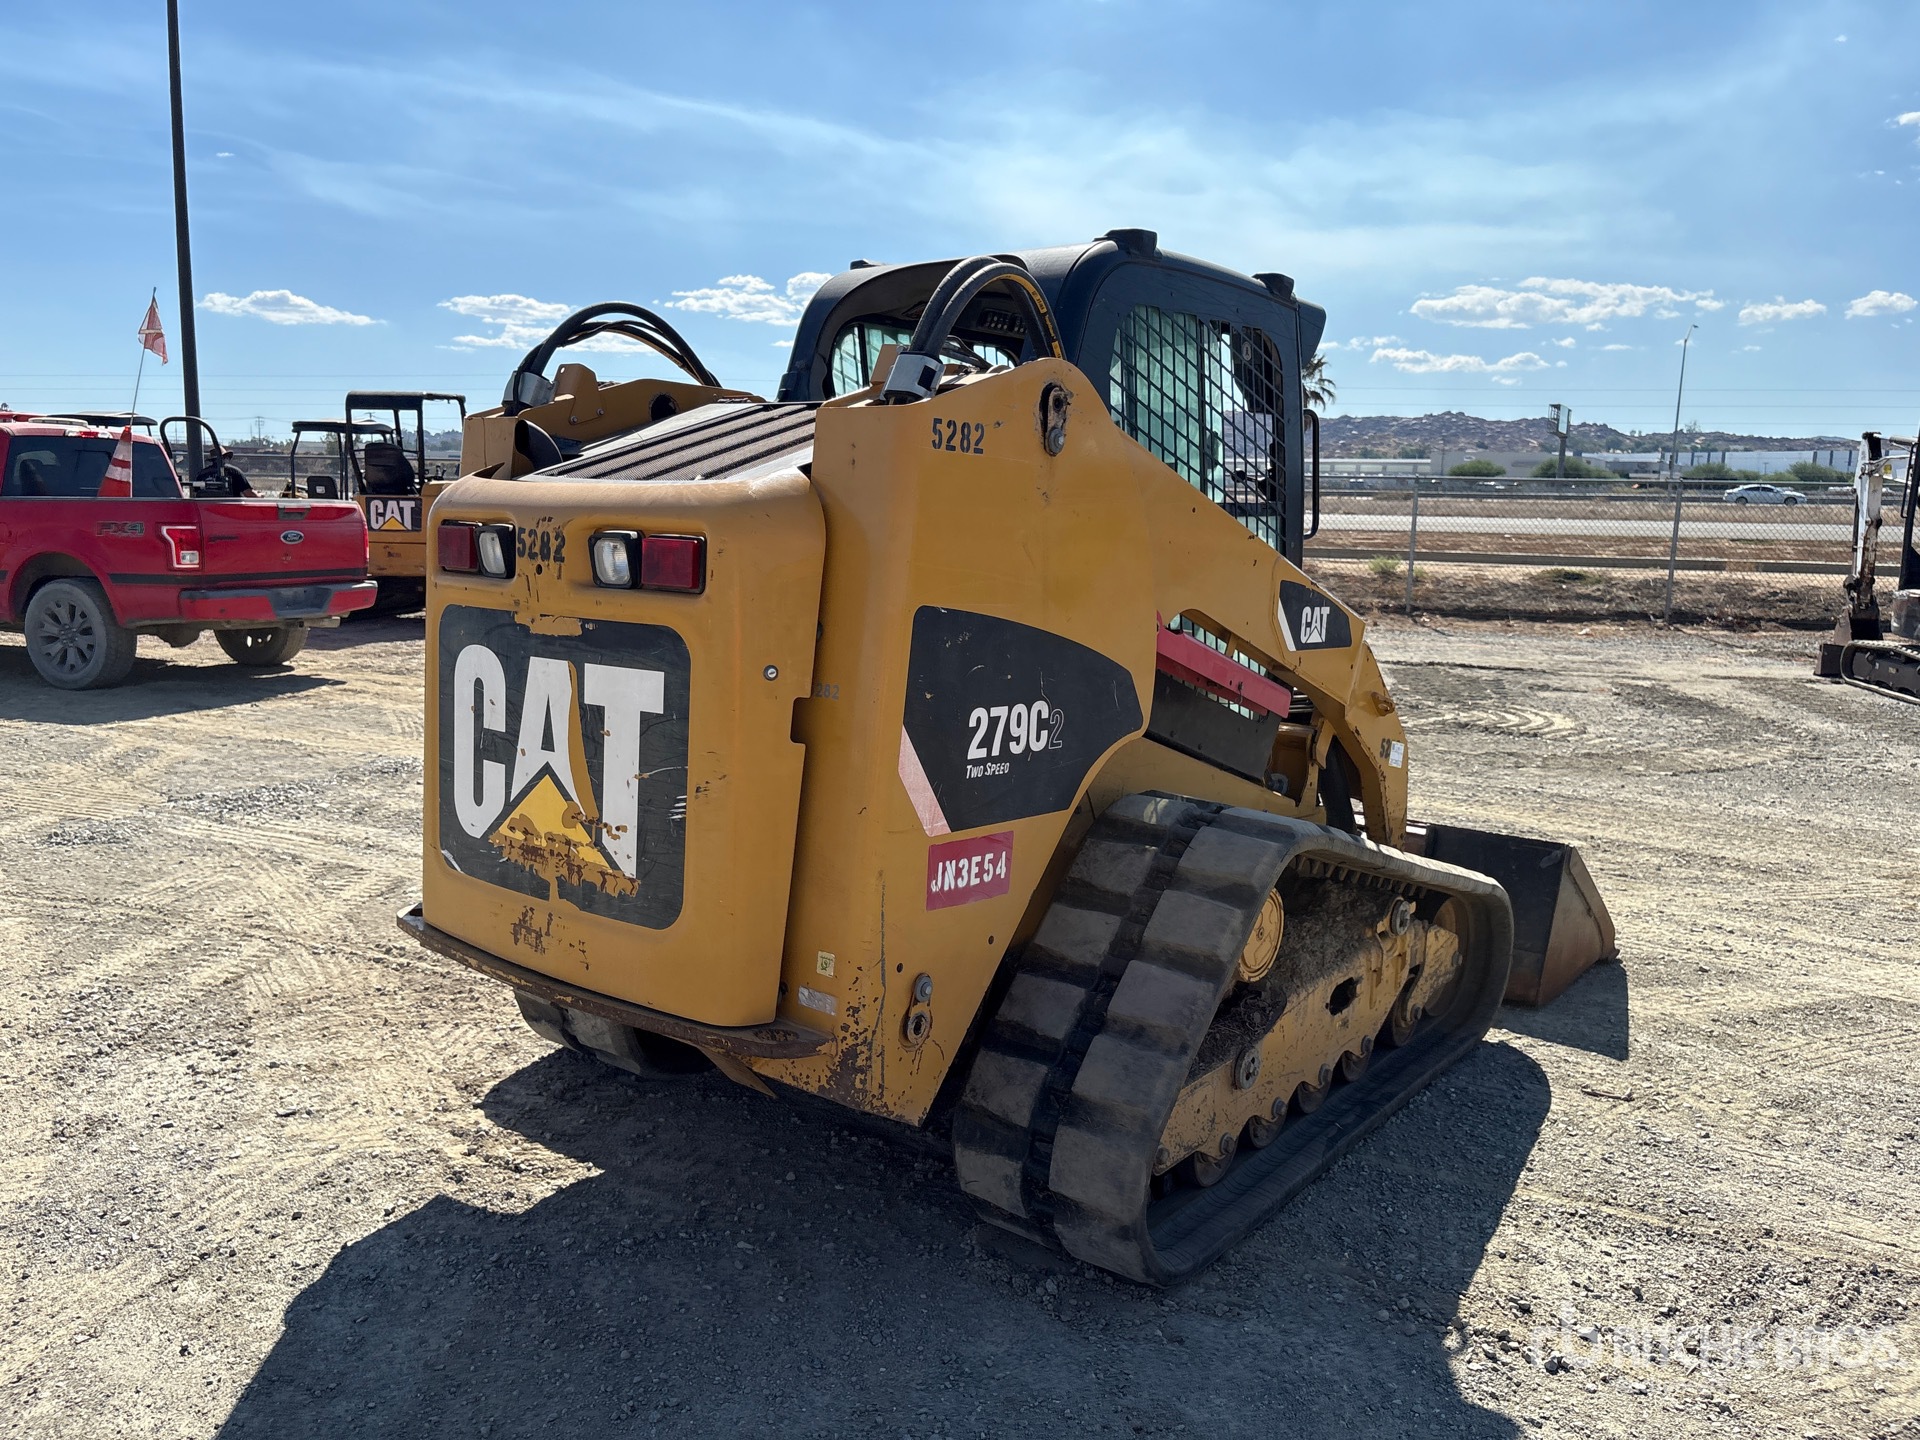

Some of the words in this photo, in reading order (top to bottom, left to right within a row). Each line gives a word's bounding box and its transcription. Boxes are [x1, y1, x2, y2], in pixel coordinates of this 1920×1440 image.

[932, 418, 985, 454] 5282
[96, 521, 145, 537] FX4
[370, 499, 415, 531] CAT
[517, 527, 566, 565] 5282
[1300, 606, 1330, 644] CAT
[815, 682, 841, 702] 282
[454, 644, 665, 880] CAT
[931, 851, 1007, 893] JN3E54
